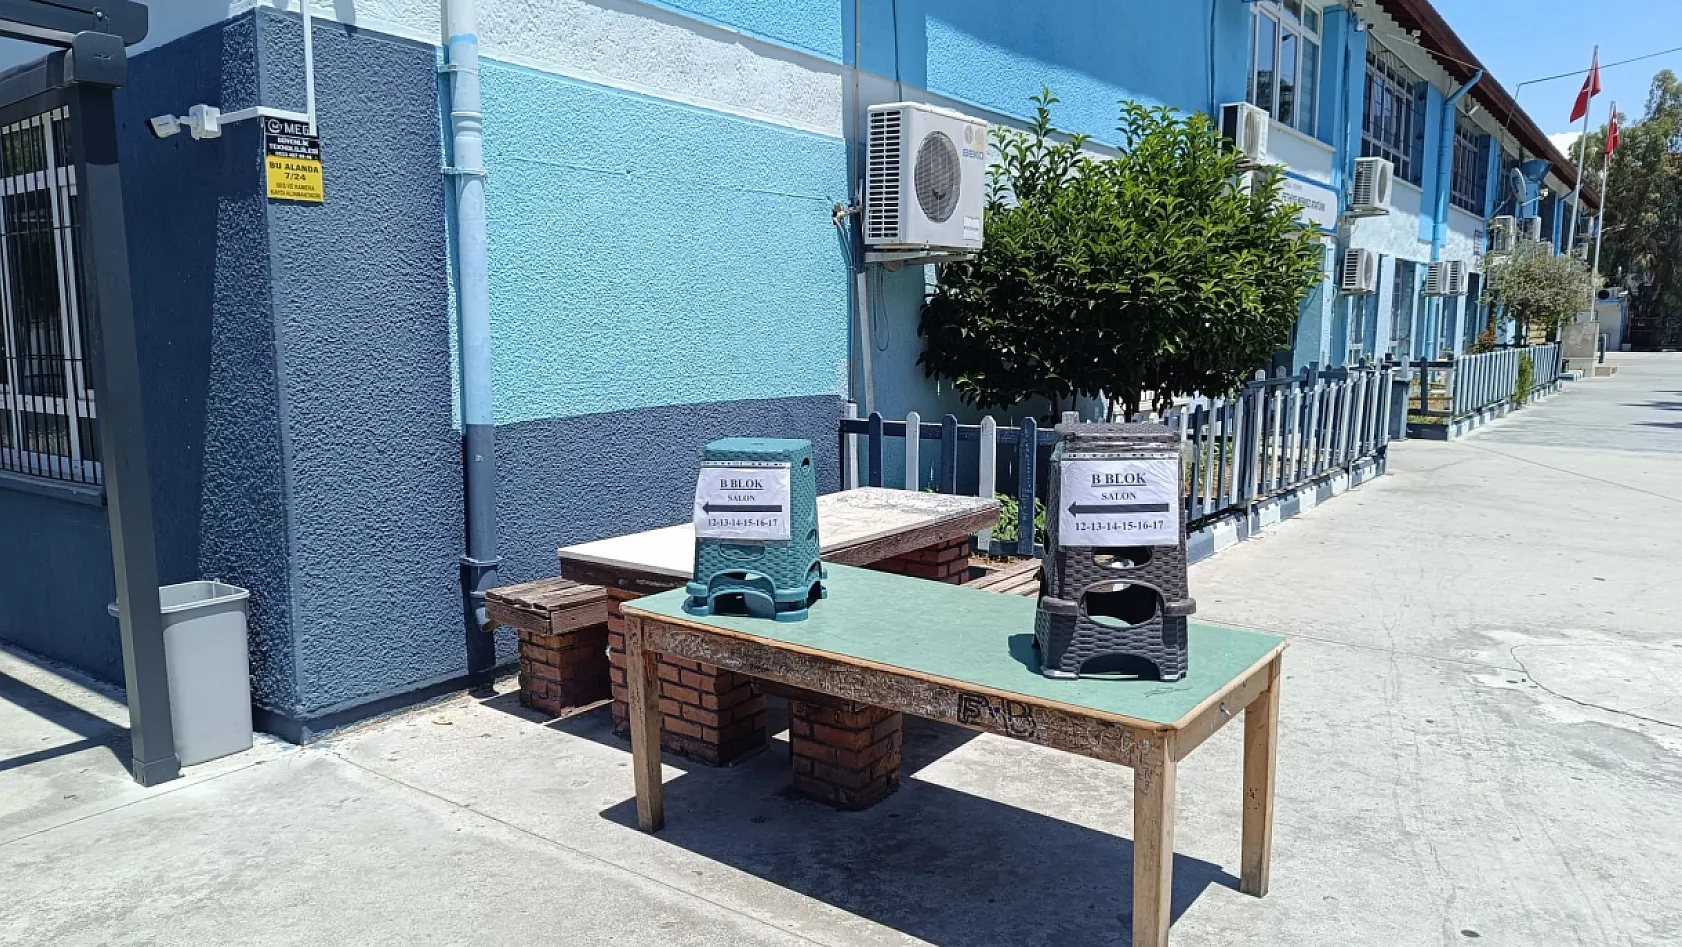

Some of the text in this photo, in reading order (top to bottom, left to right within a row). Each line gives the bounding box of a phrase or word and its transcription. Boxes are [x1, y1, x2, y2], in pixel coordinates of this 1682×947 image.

[284, 122, 310, 135] MEG
[962, 148, 984, 160] BEKO
[269, 161, 319, 173] BU ALANDA
[284, 172, 306, 180] 7/24
[720, 478, 763, 488] B BLOK
[1091, 473, 1146, 484] B BLOK
[727, 494, 755, 502] SALON
[1101, 492, 1137, 501] SALON
[708, 518, 778, 527] 12-13-14-15-16-17
[1075, 520, 1164, 531] 12-13-14-15-16-17
